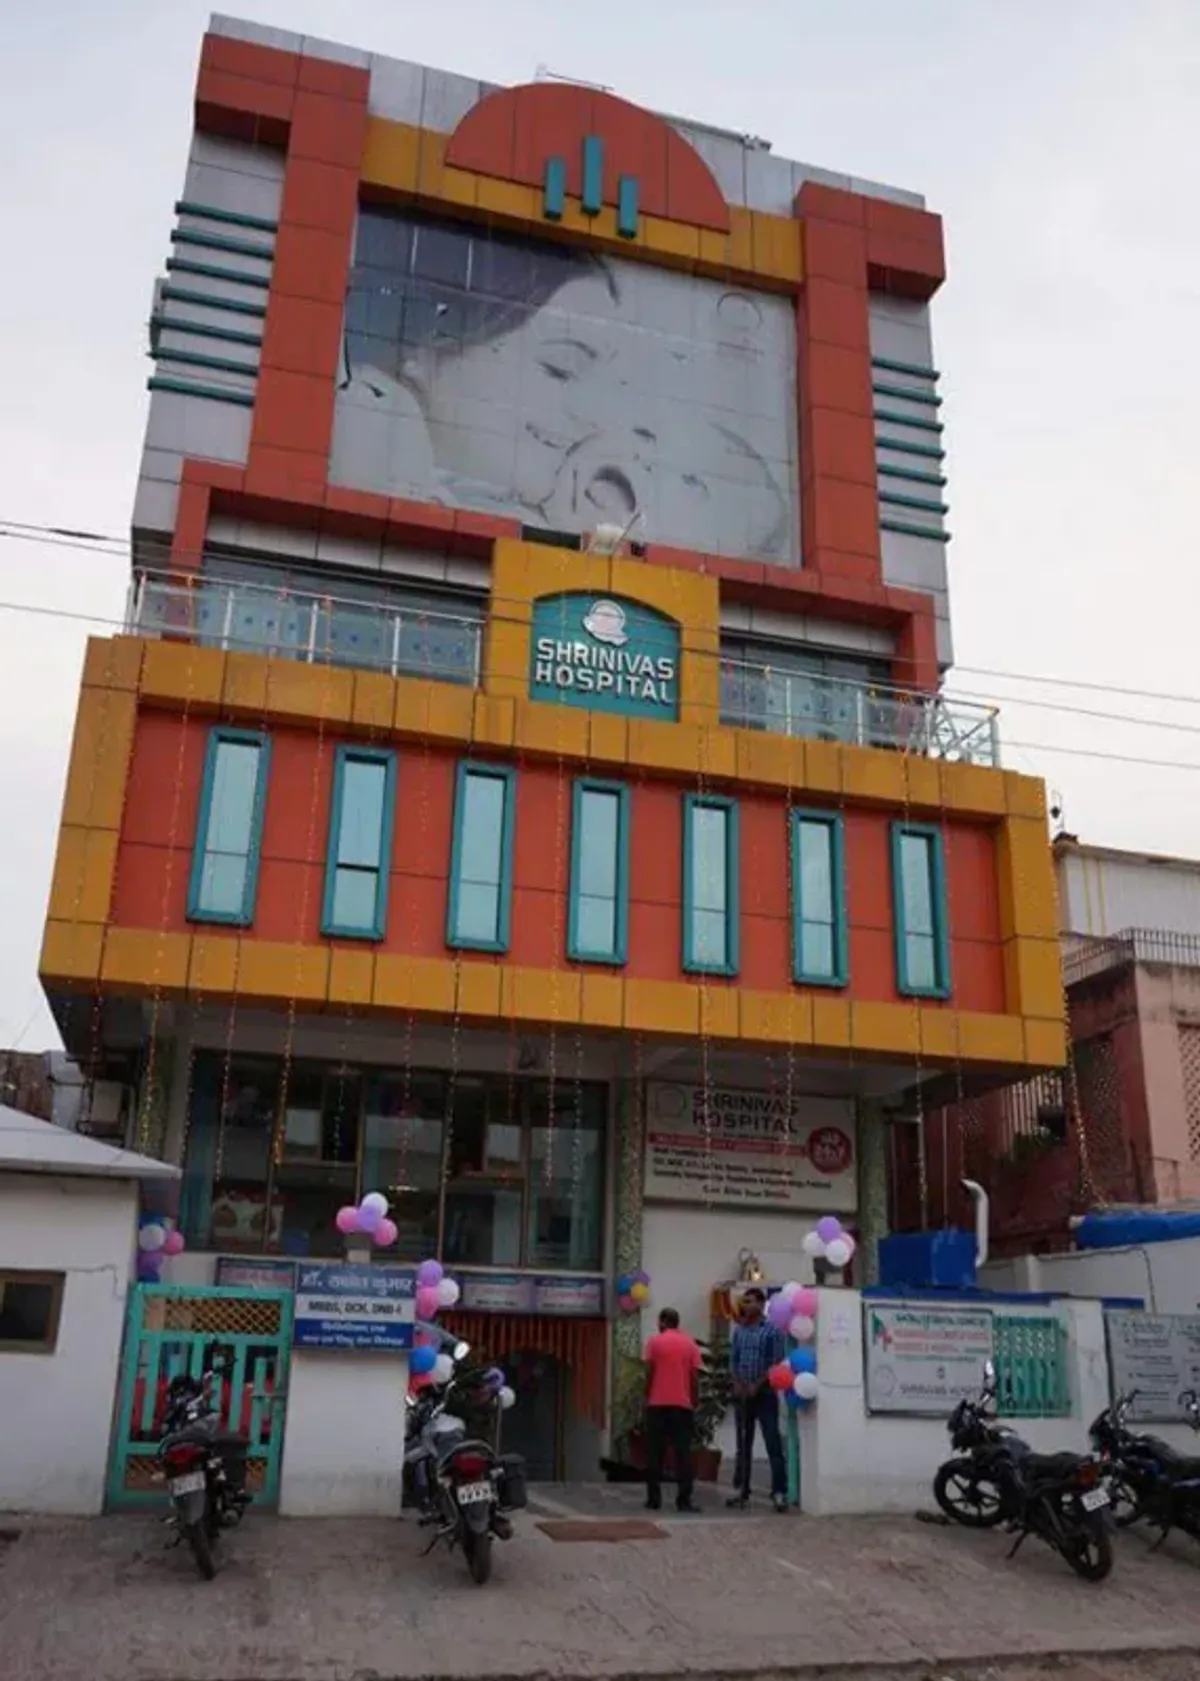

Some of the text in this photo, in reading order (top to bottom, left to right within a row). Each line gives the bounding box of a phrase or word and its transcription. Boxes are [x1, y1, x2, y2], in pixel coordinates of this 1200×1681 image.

[536, 637, 674, 681] SHRINIVAS
[535, 661, 674, 705] HOSPITAL
[692, 1090, 799, 1115] SHRINIVAS
[692, 1111, 798, 1134] HOSPITAL
